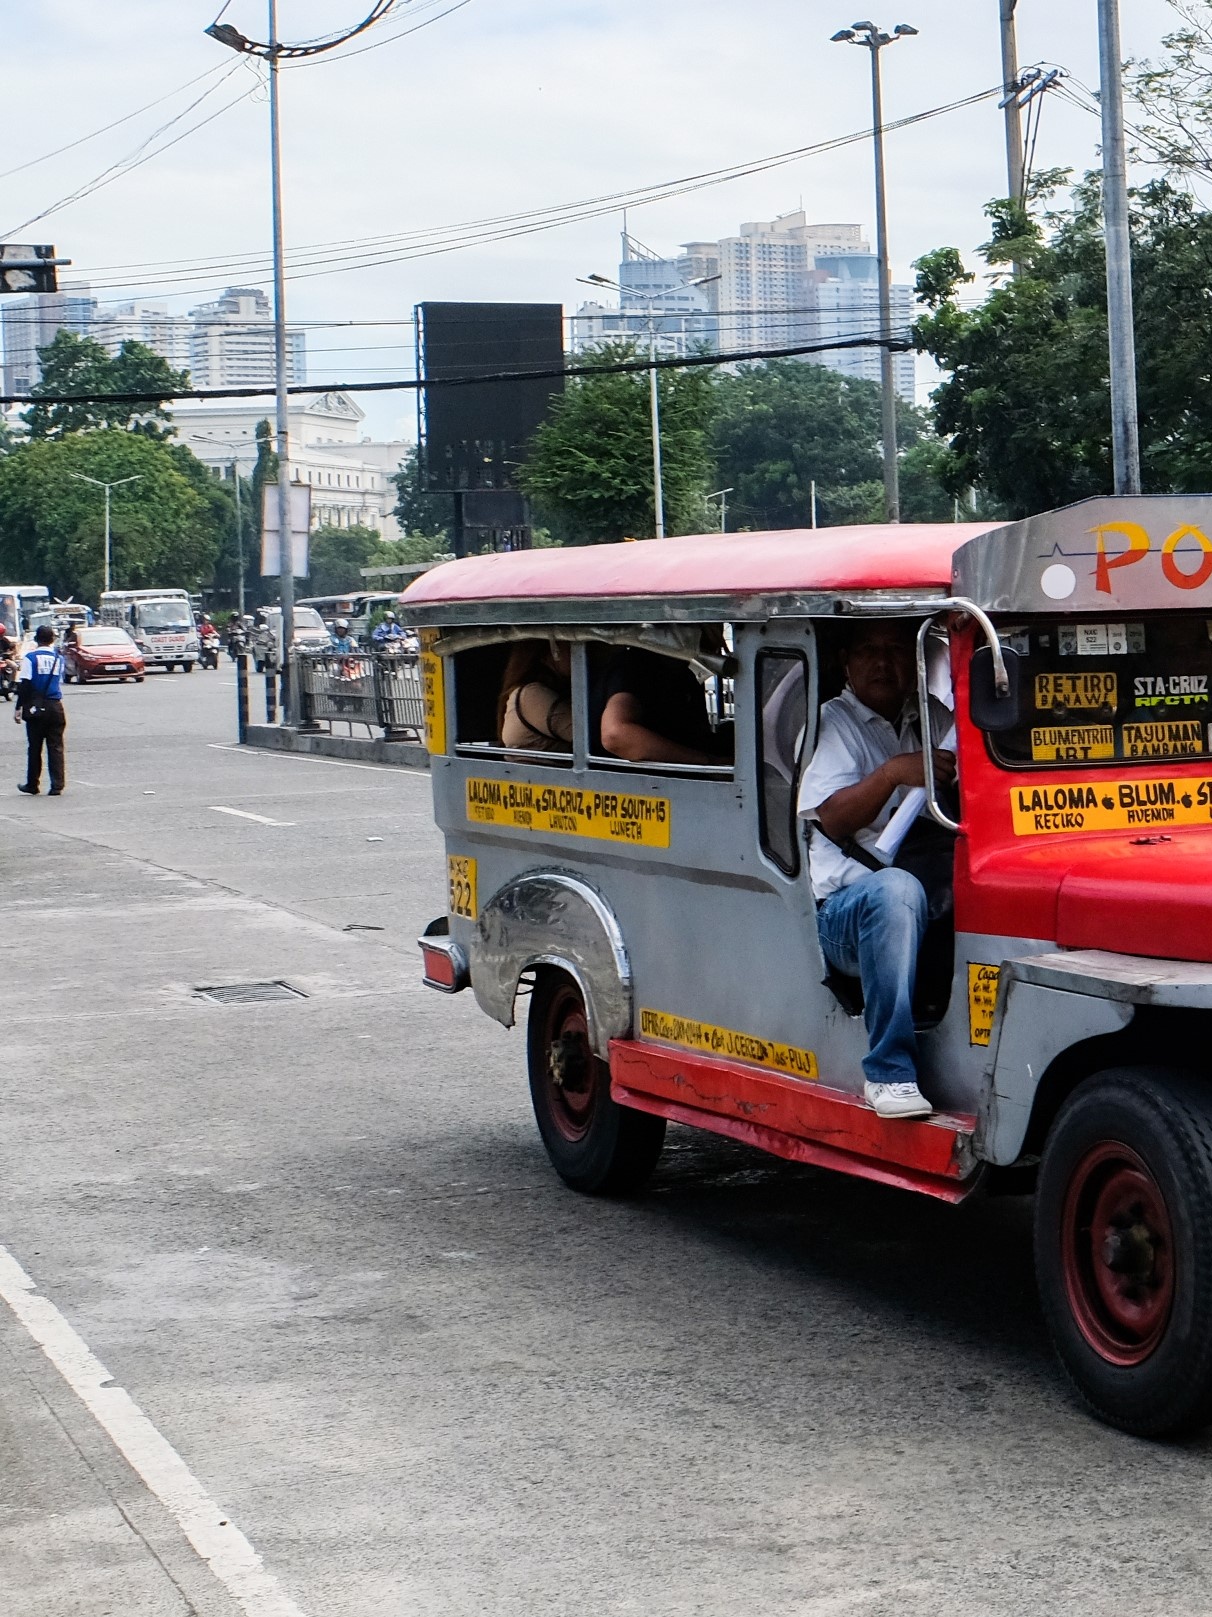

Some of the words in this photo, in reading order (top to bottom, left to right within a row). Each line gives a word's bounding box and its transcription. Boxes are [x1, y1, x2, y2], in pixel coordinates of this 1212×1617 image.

[1038, 674, 1115, 694] RETIRO
[1124, 723, 1201, 744] TAYUMAN
[1130, 742, 1197, 756] BAMBANG
[468, 780, 502, 807] LALOMA
[593, 793, 618, 818] PIER
[1018, 786, 1099, 812] LALOMA
[609, 820, 643, 840] LUNETA
[1034, 812, 1084, 831] RETIRO
